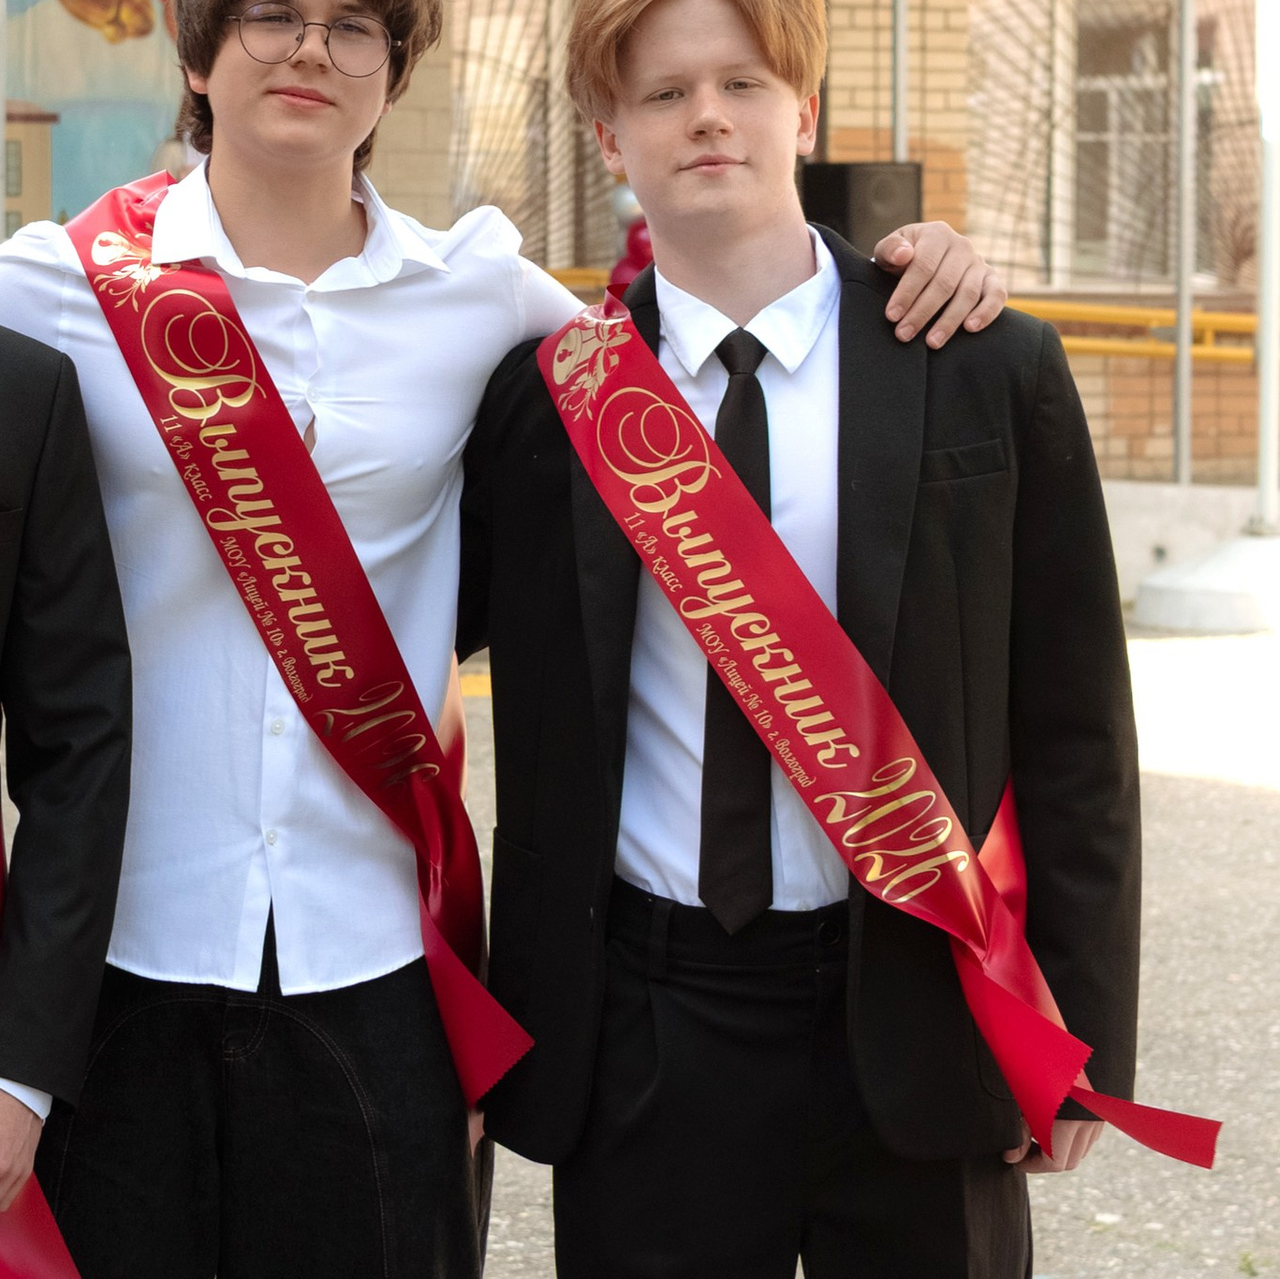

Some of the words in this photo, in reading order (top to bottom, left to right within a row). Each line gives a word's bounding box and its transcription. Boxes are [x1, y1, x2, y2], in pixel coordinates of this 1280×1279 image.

[141, 288, 355, 689] Выпускник
[160, 414, 182, 433] 11
[184, 462, 212, 503] класс
[219, 535, 252, 570] МОУ
[237, 571, 268, 613] «Лицей
[282, 655, 314, 704] Волгоград
[624, 511, 646, 531] 11
[652, 555, 683, 593] класс
[596, 386, 861, 769] Выпускник
[813, 757, 970, 904] 2026
[695, 623, 730, 656] МОУ
[718, 655, 752, 697] «Лицей
[774, 738, 817, 789] Волгоград
